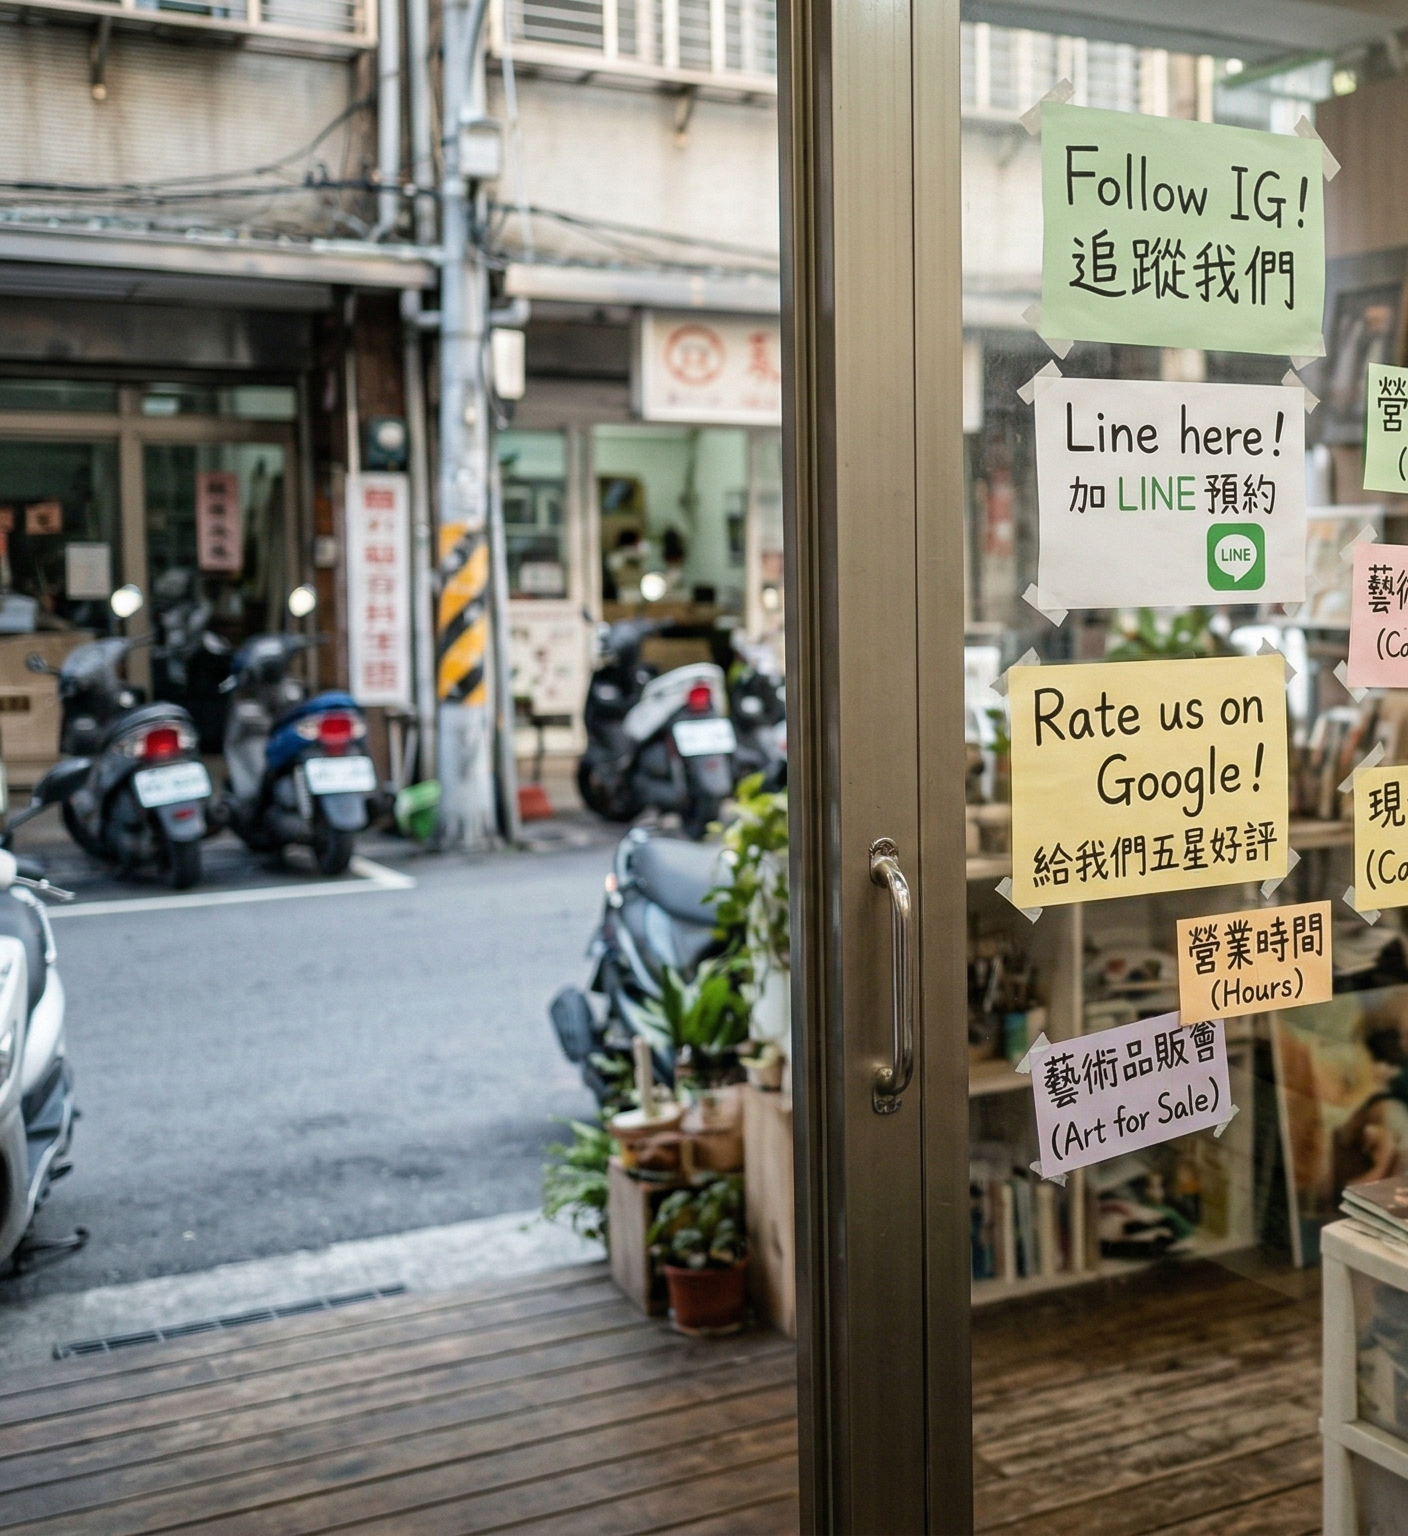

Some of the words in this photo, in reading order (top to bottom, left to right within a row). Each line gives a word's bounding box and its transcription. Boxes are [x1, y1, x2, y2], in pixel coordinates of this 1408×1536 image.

[1065, 145, 1208, 217] Follow
[1230, 165, 1309, 229] IG!
[1068, 228, 1295, 311] 追蹤我們
[1066, 401, 1159, 454] Line
[1180, 403, 1285, 457] here!
[1118, 475, 1196, 512] LINE
[1221, 548, 1251, 562] LINE
[1034, 687, 1141, 747] Rate
[1160, 698, 1204, 732] us
[1220, 695, 1264, 726] on
[1097, 742, 1265, 818] Google!
[1032, 821, 1278, 888] 給我們五星好評
[1188, 912, 1324, 976] 營業時間
[1211, 968, 1305, 1010] (Hours)
[1051, 1117, 1107, 1161] (Art
[1112, 1104, 1150, 1138] for
[1157, 1076, 1220, 1124] Sale)
